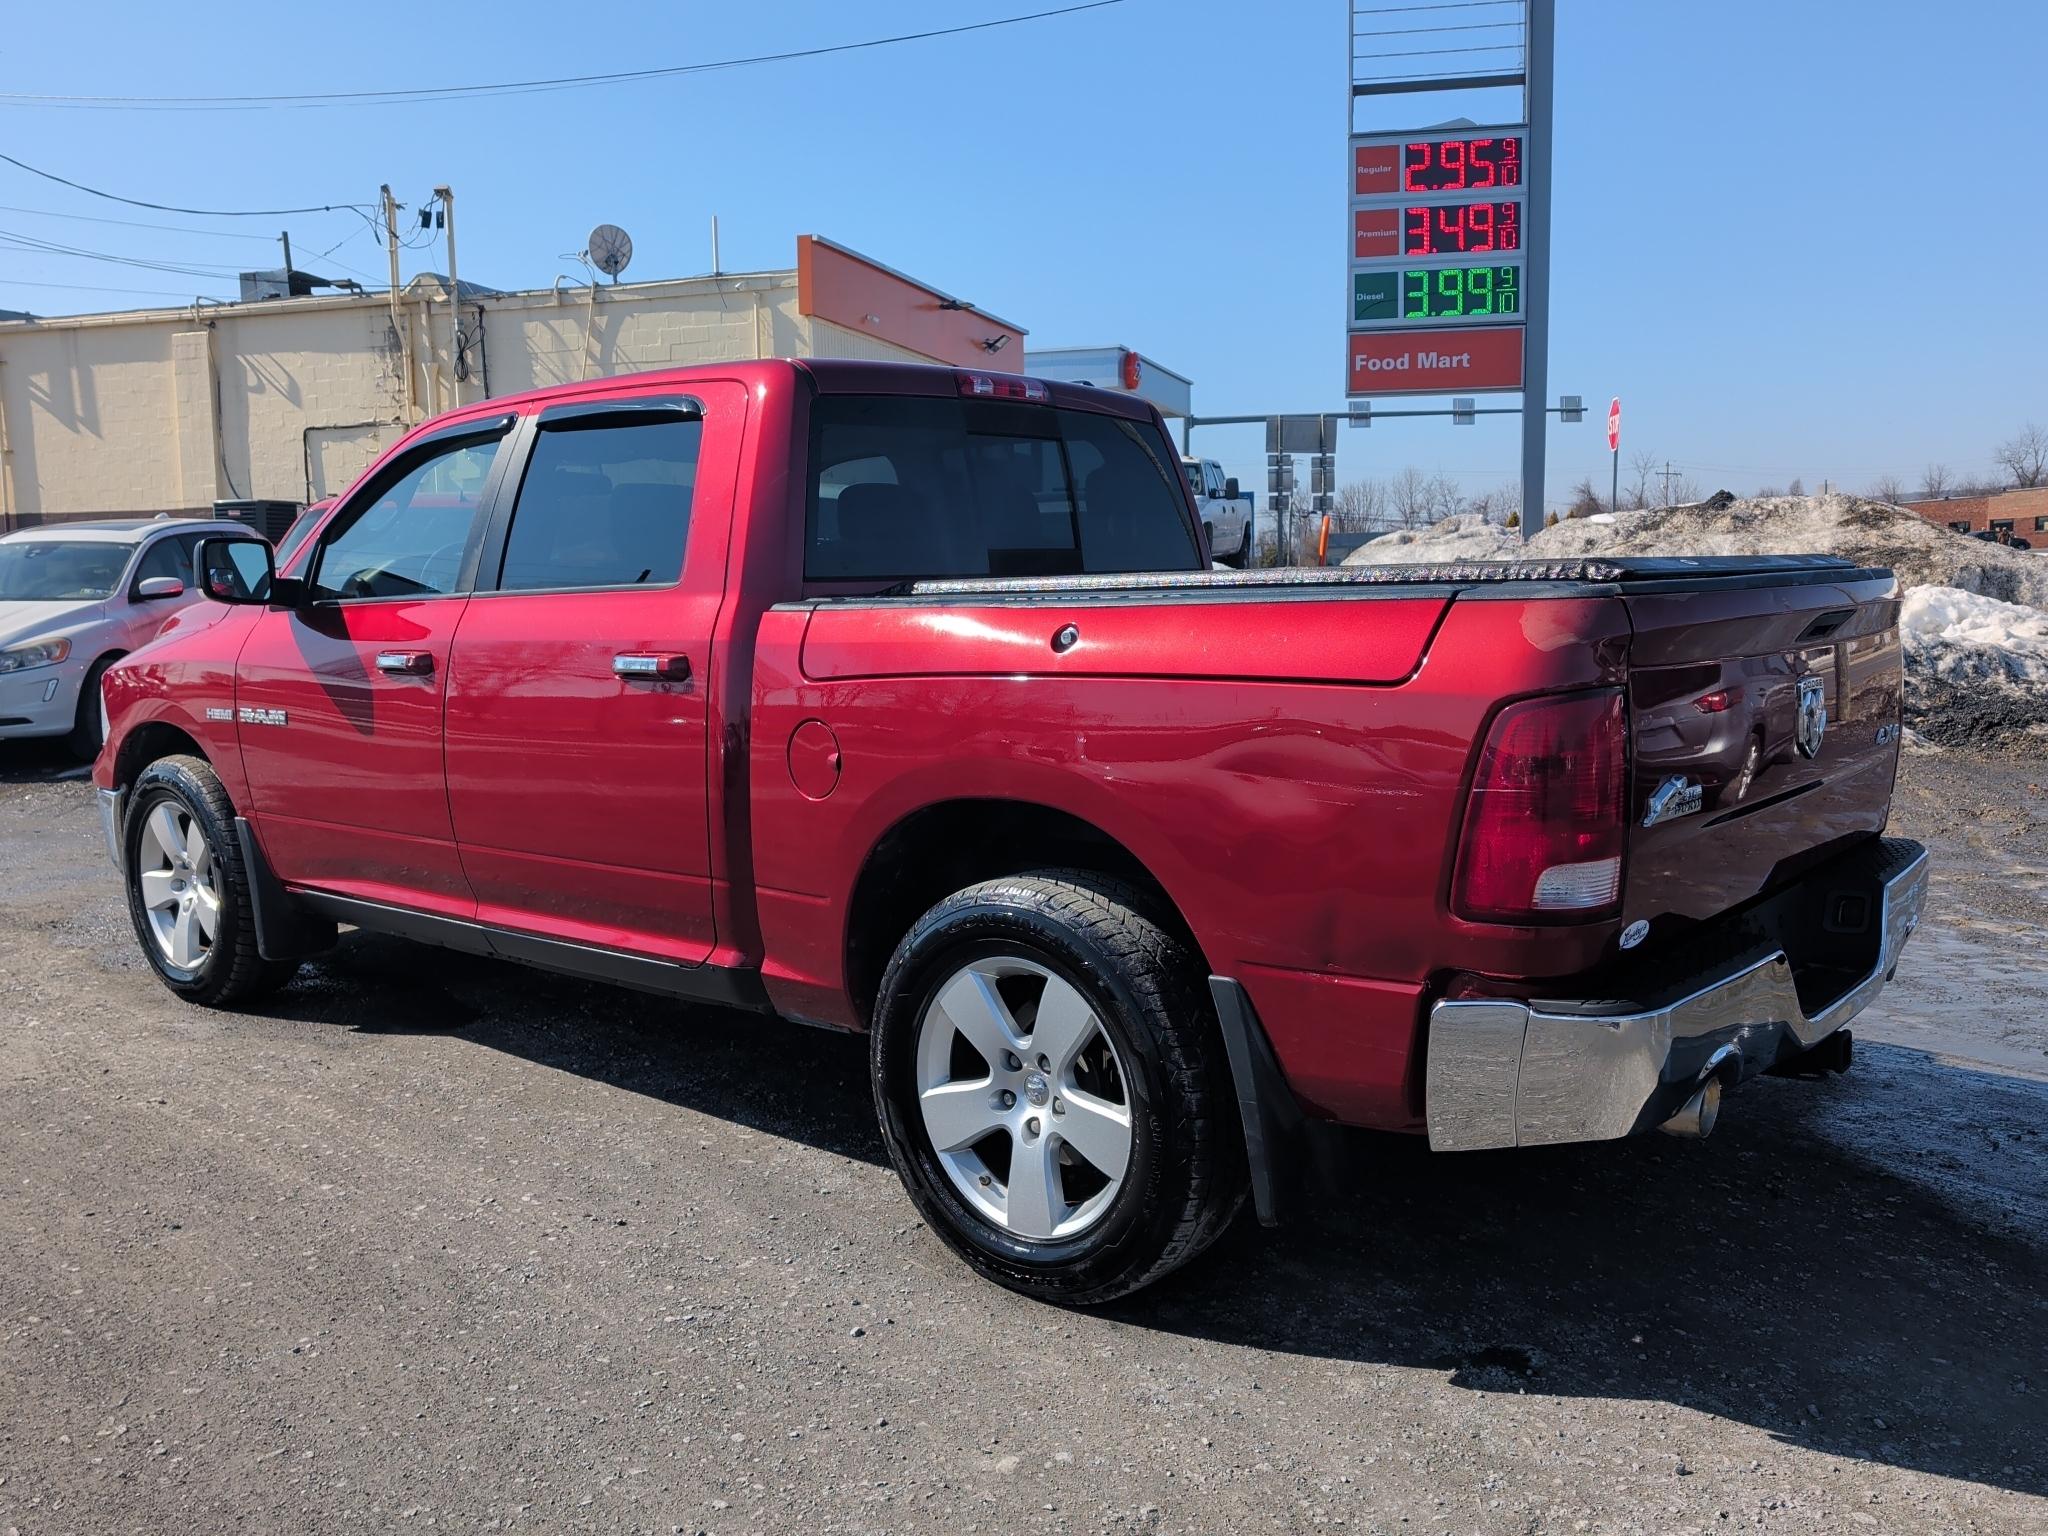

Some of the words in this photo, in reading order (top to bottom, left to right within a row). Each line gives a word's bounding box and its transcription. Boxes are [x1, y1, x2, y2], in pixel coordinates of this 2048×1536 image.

[1357, 165, 1393, 175] Regular
[1405, 139, 1495, 192] 2.95
[1357, 229, 1398, 238] Premium
[1406, 203, 1494, 257] 3.49
[1356, 292, 1384, 302] Diesel
[1405, 267, 1493, 320] 3.99
[1355, 352, 1410, 372] Food
[1417, 352, 1471, 369] Mart
[1609, 414, 1620, 435] STOP
[1802, 679, 1824, 690] DODGE
[206, 707, 235, 721] HEMI
[239, 707, 288, 726] RAM
